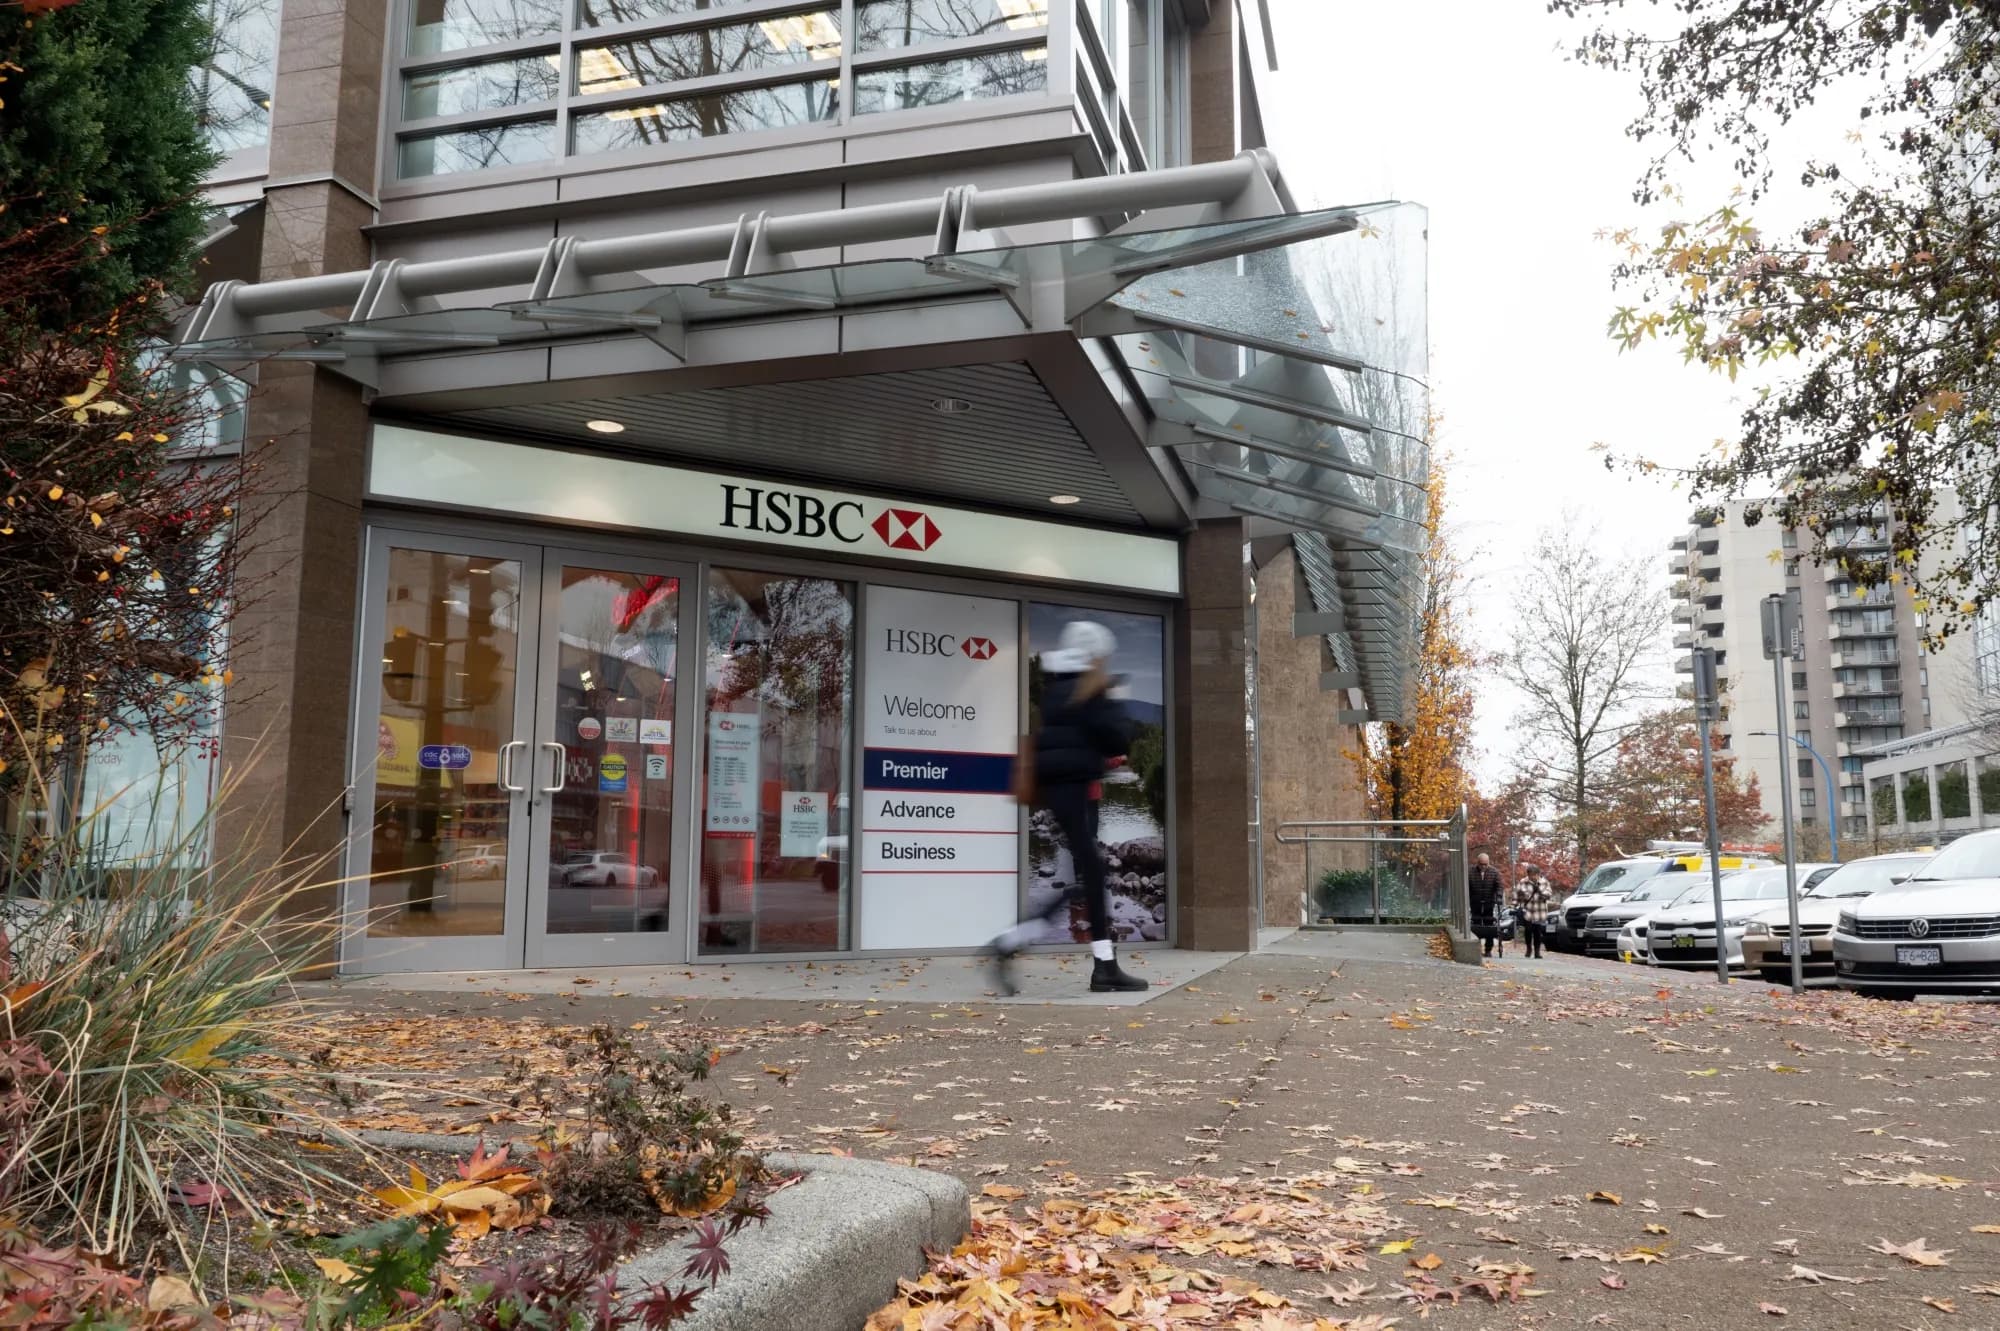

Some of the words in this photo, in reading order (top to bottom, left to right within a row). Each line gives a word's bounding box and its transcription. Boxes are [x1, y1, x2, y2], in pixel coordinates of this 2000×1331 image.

[720, 484, 864, 543] HSBC
[886, 628, 955, 657] HSBC
[884, 694, 975, 721] Welcome
[883, 725, 897, 734] Talk
[898, 727, 906, 735] to
[908, 728, 915, 736] us
[917, 727, 937, 737] about
[94, 752, 122, 767] today
[882, 759, 949, 780] Premier
[793, 804, 816, 814] HSBC
[880, 800, 955, 819] Advance
[881, 842, 956, 860] Business
